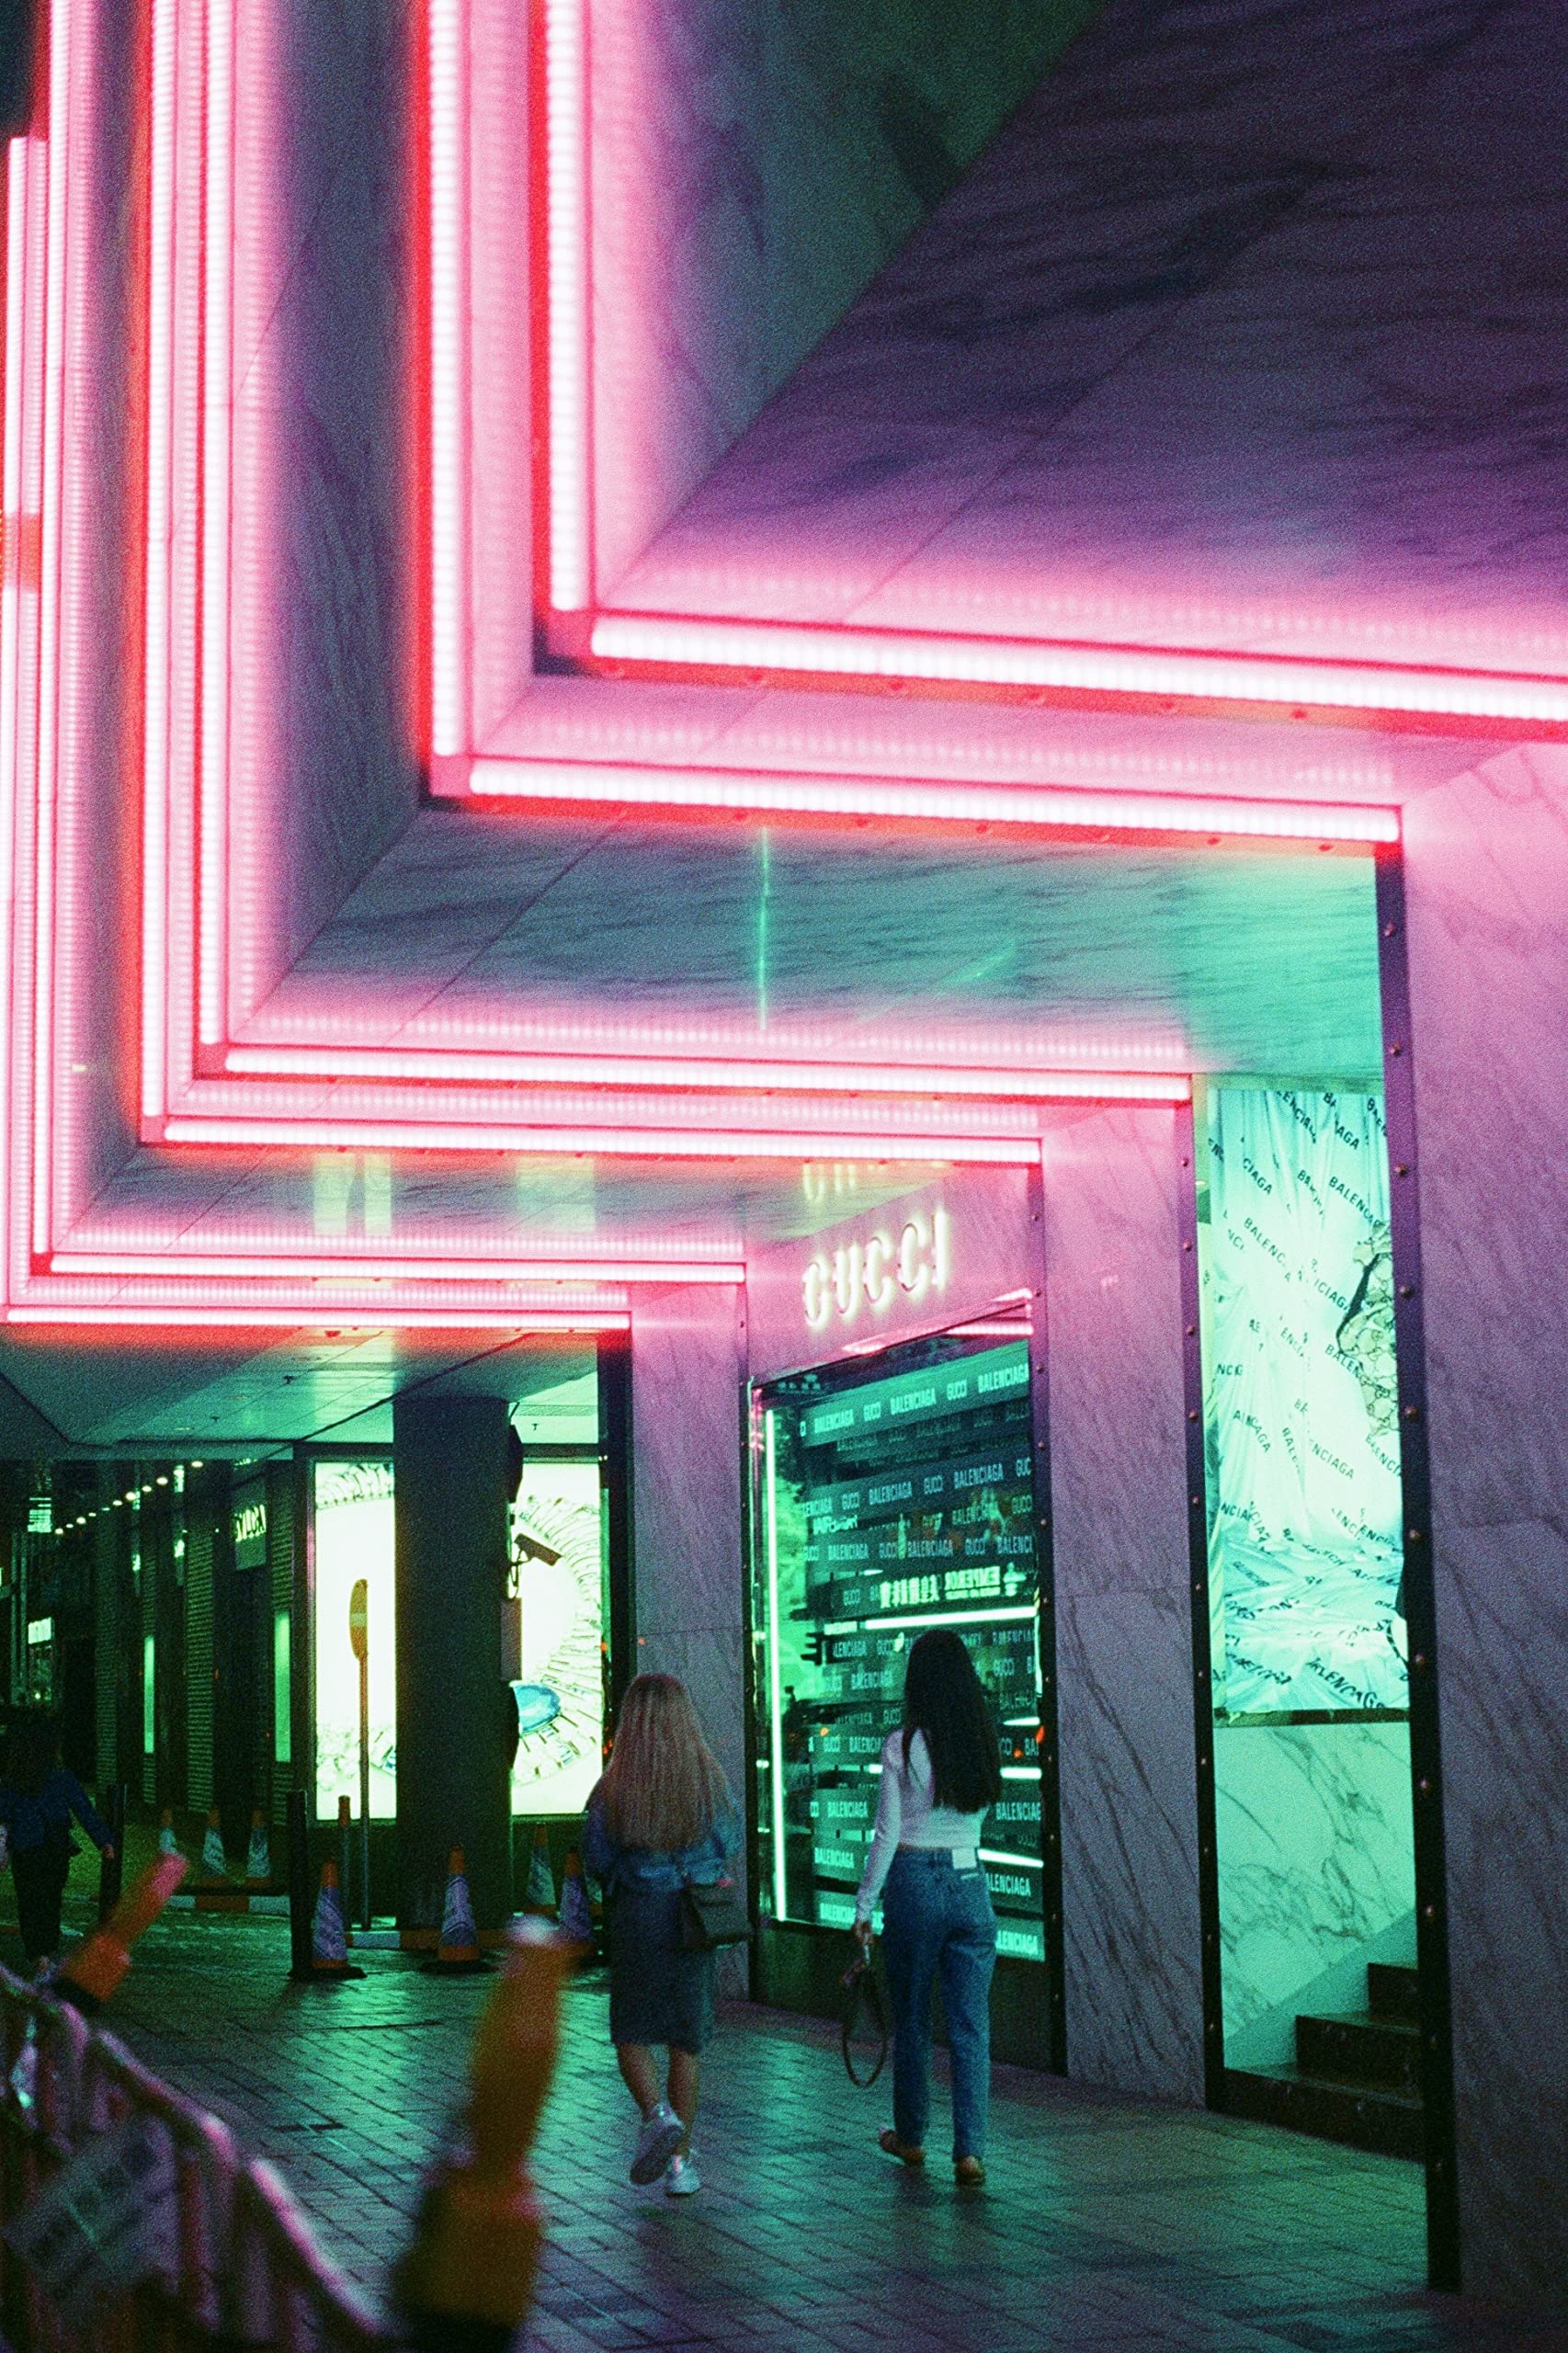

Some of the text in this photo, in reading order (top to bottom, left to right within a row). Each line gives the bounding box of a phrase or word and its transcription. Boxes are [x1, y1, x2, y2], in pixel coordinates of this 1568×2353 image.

[803, 1206, 949, 1329] GUCCI
[813, 1408, 855, 1434] BALENCIAGA
[863, 1402, 881, 1422] GUCCI
[890, 1387, 937, 1415] BALENCIAGA
[946, 1380, 968, 1401] GUCCI
[842, 1491, 860, 1510] GUCCI
[869, 1481, 913, 1506] BALENCIAGA
[924, 1474, 943, 1495] GUCCI
[954, 1461, 1004, 1490] BALENCIAGA
[828, 1542, 869, 1561] BALENCIAGA
[907, 1539, 954, 1558] BALENCIAGA
[827, 1802, 869, 1818] BALENCIAGA
[814, 1847, 855, 1869] BALENCIAGA
